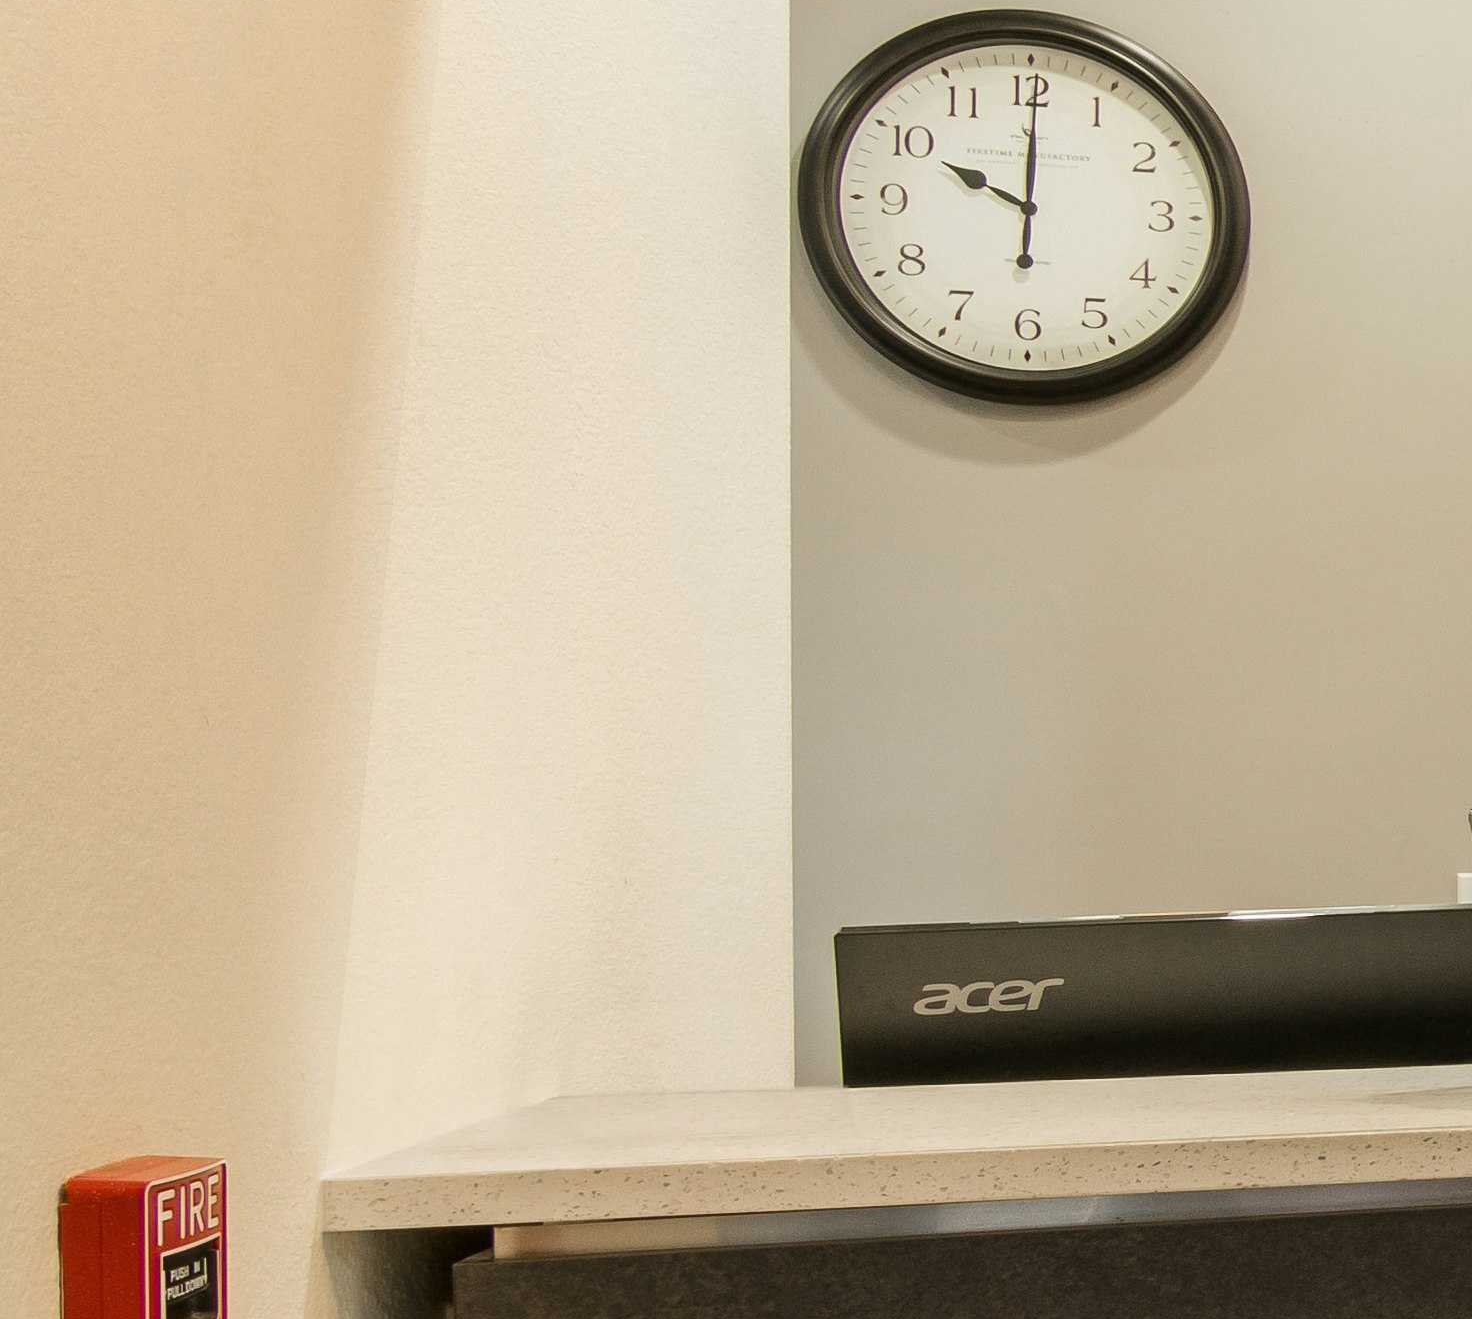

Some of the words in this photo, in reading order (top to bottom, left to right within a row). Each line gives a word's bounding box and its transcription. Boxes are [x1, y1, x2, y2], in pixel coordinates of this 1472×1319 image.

[947, 85, 979, 119] 11
[1011, 74, 1050, 107] 12
[1091, 96, 1102, 128] 1
[892, 125, 935, 159] 10
[1017, 152, 1091, 162] MUFACTORY
[1131, 141, 1157, 173] 2
[879, 183, 909, 216] 9
[1147, 200, 1176, 232] 3
[897, 243, 927, 277] 8
[1128, 258, 1157, 289] 4
[947, 289, 975, 322] 7
[1080, 297, 1109, 330] 5
[1014, 309, 1042, 342] 6
[913, 978, 1065, 1016] acer
[156, 1174, 219, 1247] FIRE
